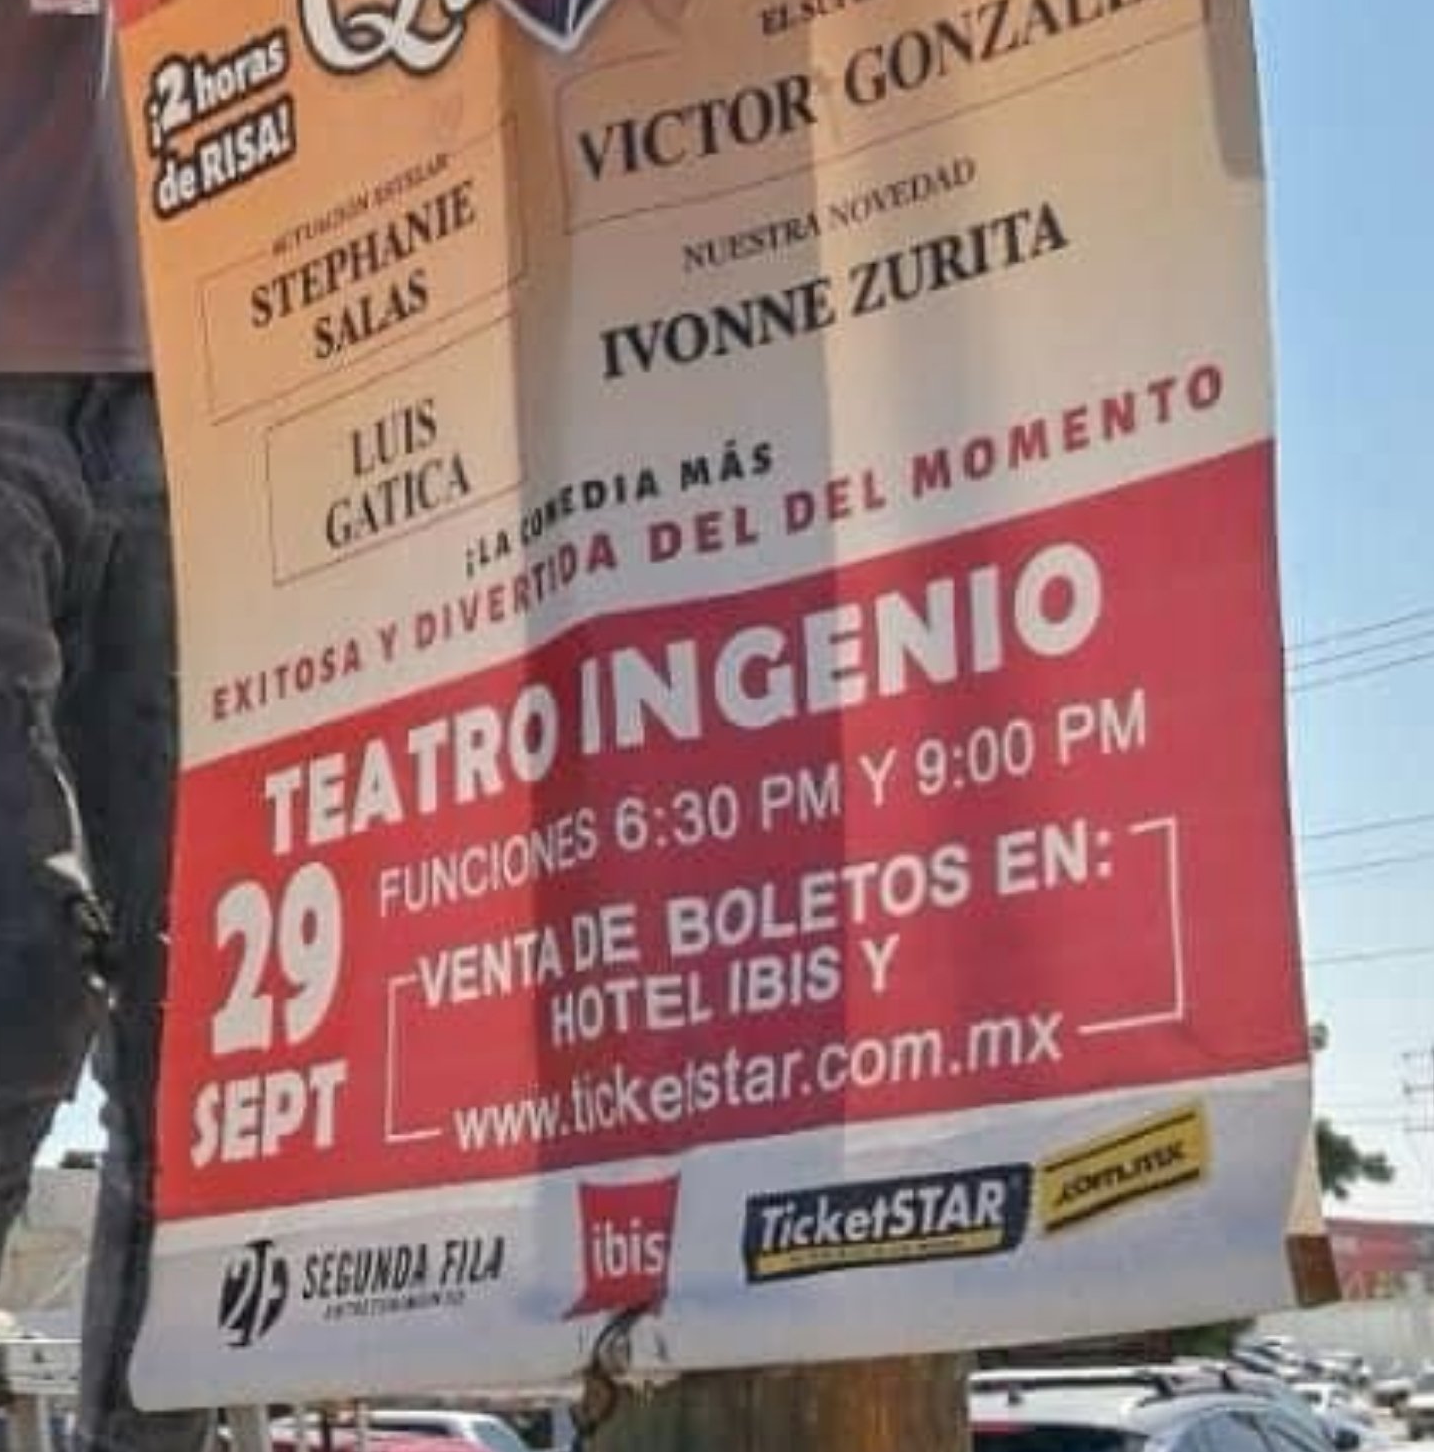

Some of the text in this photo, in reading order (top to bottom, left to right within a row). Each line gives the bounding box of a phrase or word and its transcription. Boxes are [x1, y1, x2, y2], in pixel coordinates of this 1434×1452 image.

[195, 36, 286, 109] horas
[578, 72, 817, 181] VICTOR
[157, 102, 294, 213] de RISA!
[251, 179, 476, 329] STEPHANIE
[681, 156, 976, 274] NUESTRA NOVEDAD
[314, 271, 430, 360] SALAS
[600, 202, 1069, 380] IVONNE ZURITA
[351, 398, 438, 476] LUIS
[679, 439, 773, 490] MÁS
[211, 363, 1224, 722] EXITOSA Y DIVERTIDA DEL DEL MOMENTO
[325, 454, 472, 549] GATICA
[261, 542, 1102, 855] TEATRO INGENIO
[378, 687, 1148, 919] FUNCIONES 6:30 PM Y 9:00 PM
[211, 860, 343, 1055] 29
[419, 819, 1112, 1008] VENTA DE BOLETOS EN:
[550, 934, 902, 1046] HOTEL IBIS Y
[190, 1060, 349, 1169] SEPT
[453, 1010, 1065, 1151] www.ticketstar.com.mx
[302, 1235, 505, 1299] SEGUNDA FILA
[592, 1221, 667, 1279] ibis
[760, 1179, 1007, 1253] TicketSTAR
